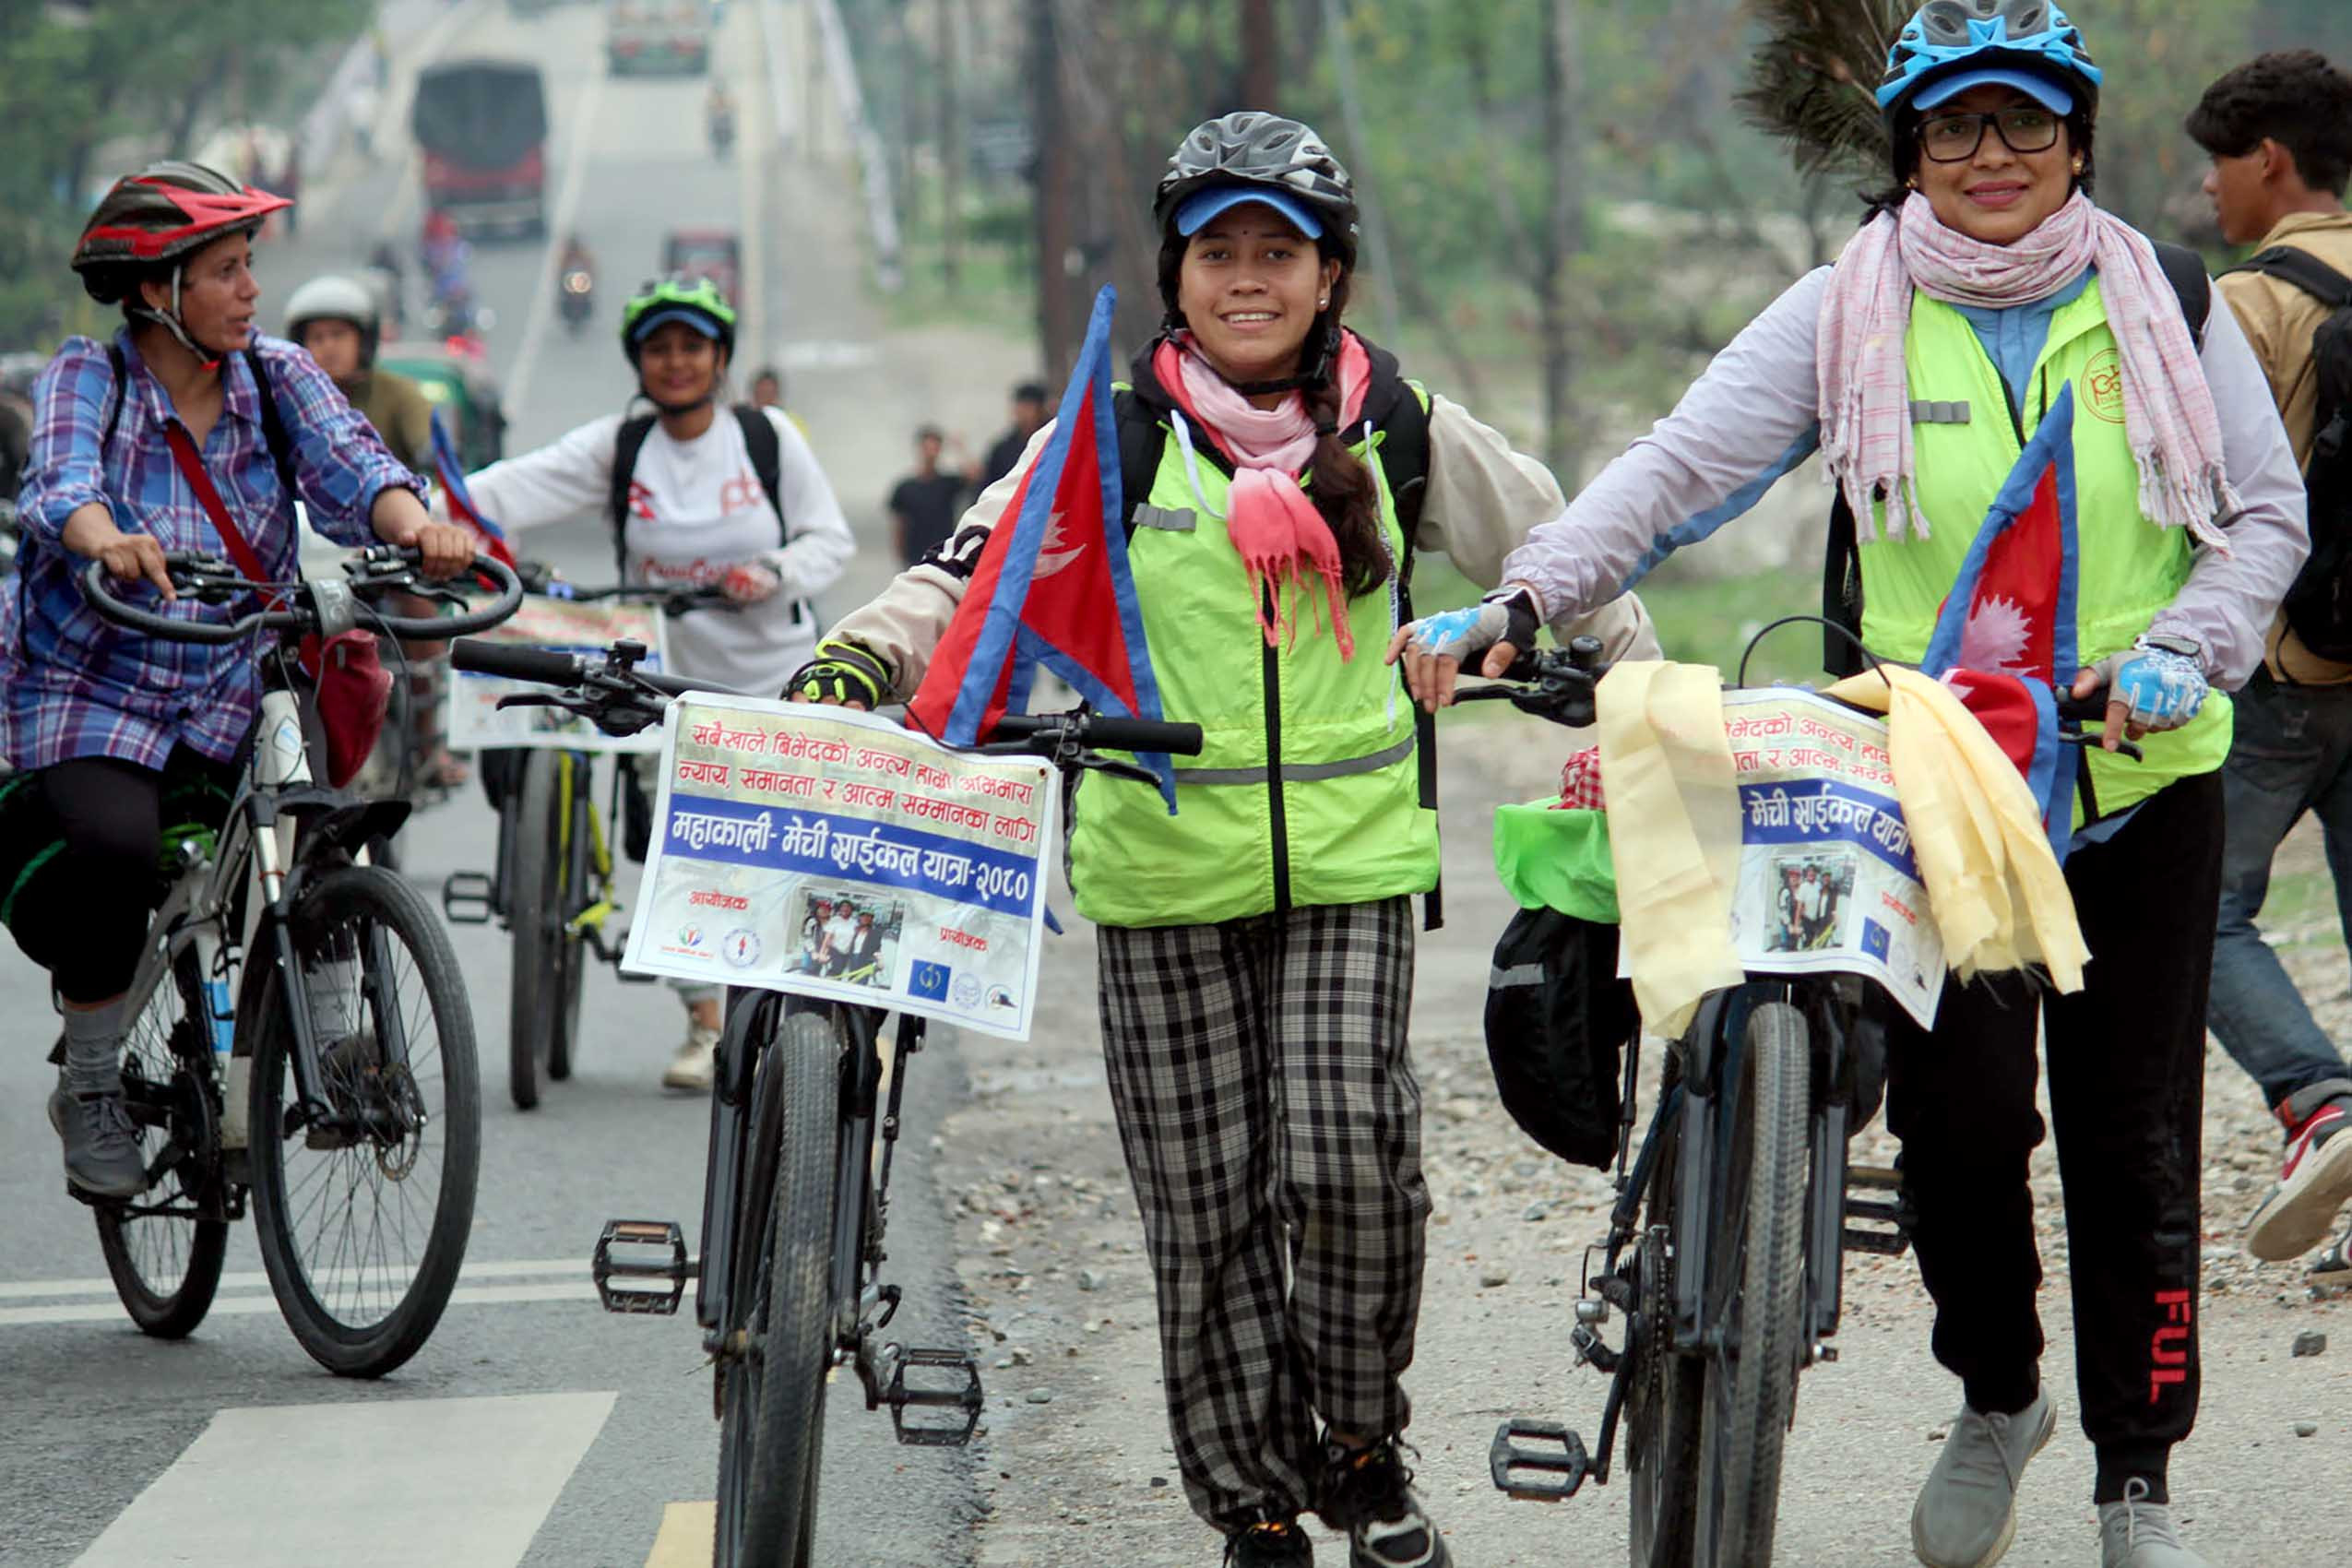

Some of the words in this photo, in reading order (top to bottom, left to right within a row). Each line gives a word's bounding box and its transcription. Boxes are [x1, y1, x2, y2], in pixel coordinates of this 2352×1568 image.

[856, 748, 911, 778] अन्त्य
[1766, 749, 1781, 768] र
[1788, 748, 1840, 772] आत्म
[740, 768, 815, 798] समानता
[822, 778, 837, 799] र
[842, 782, 896, 809] आत्म
[901, 793, 991, 831] सम्मानका
[994, 814, 1037, 843] लागि
[1748, 788, 1789, 827] मेची
[781, 814, 829, 860] मेची
[688, 888, 750, 911] आयोजक
